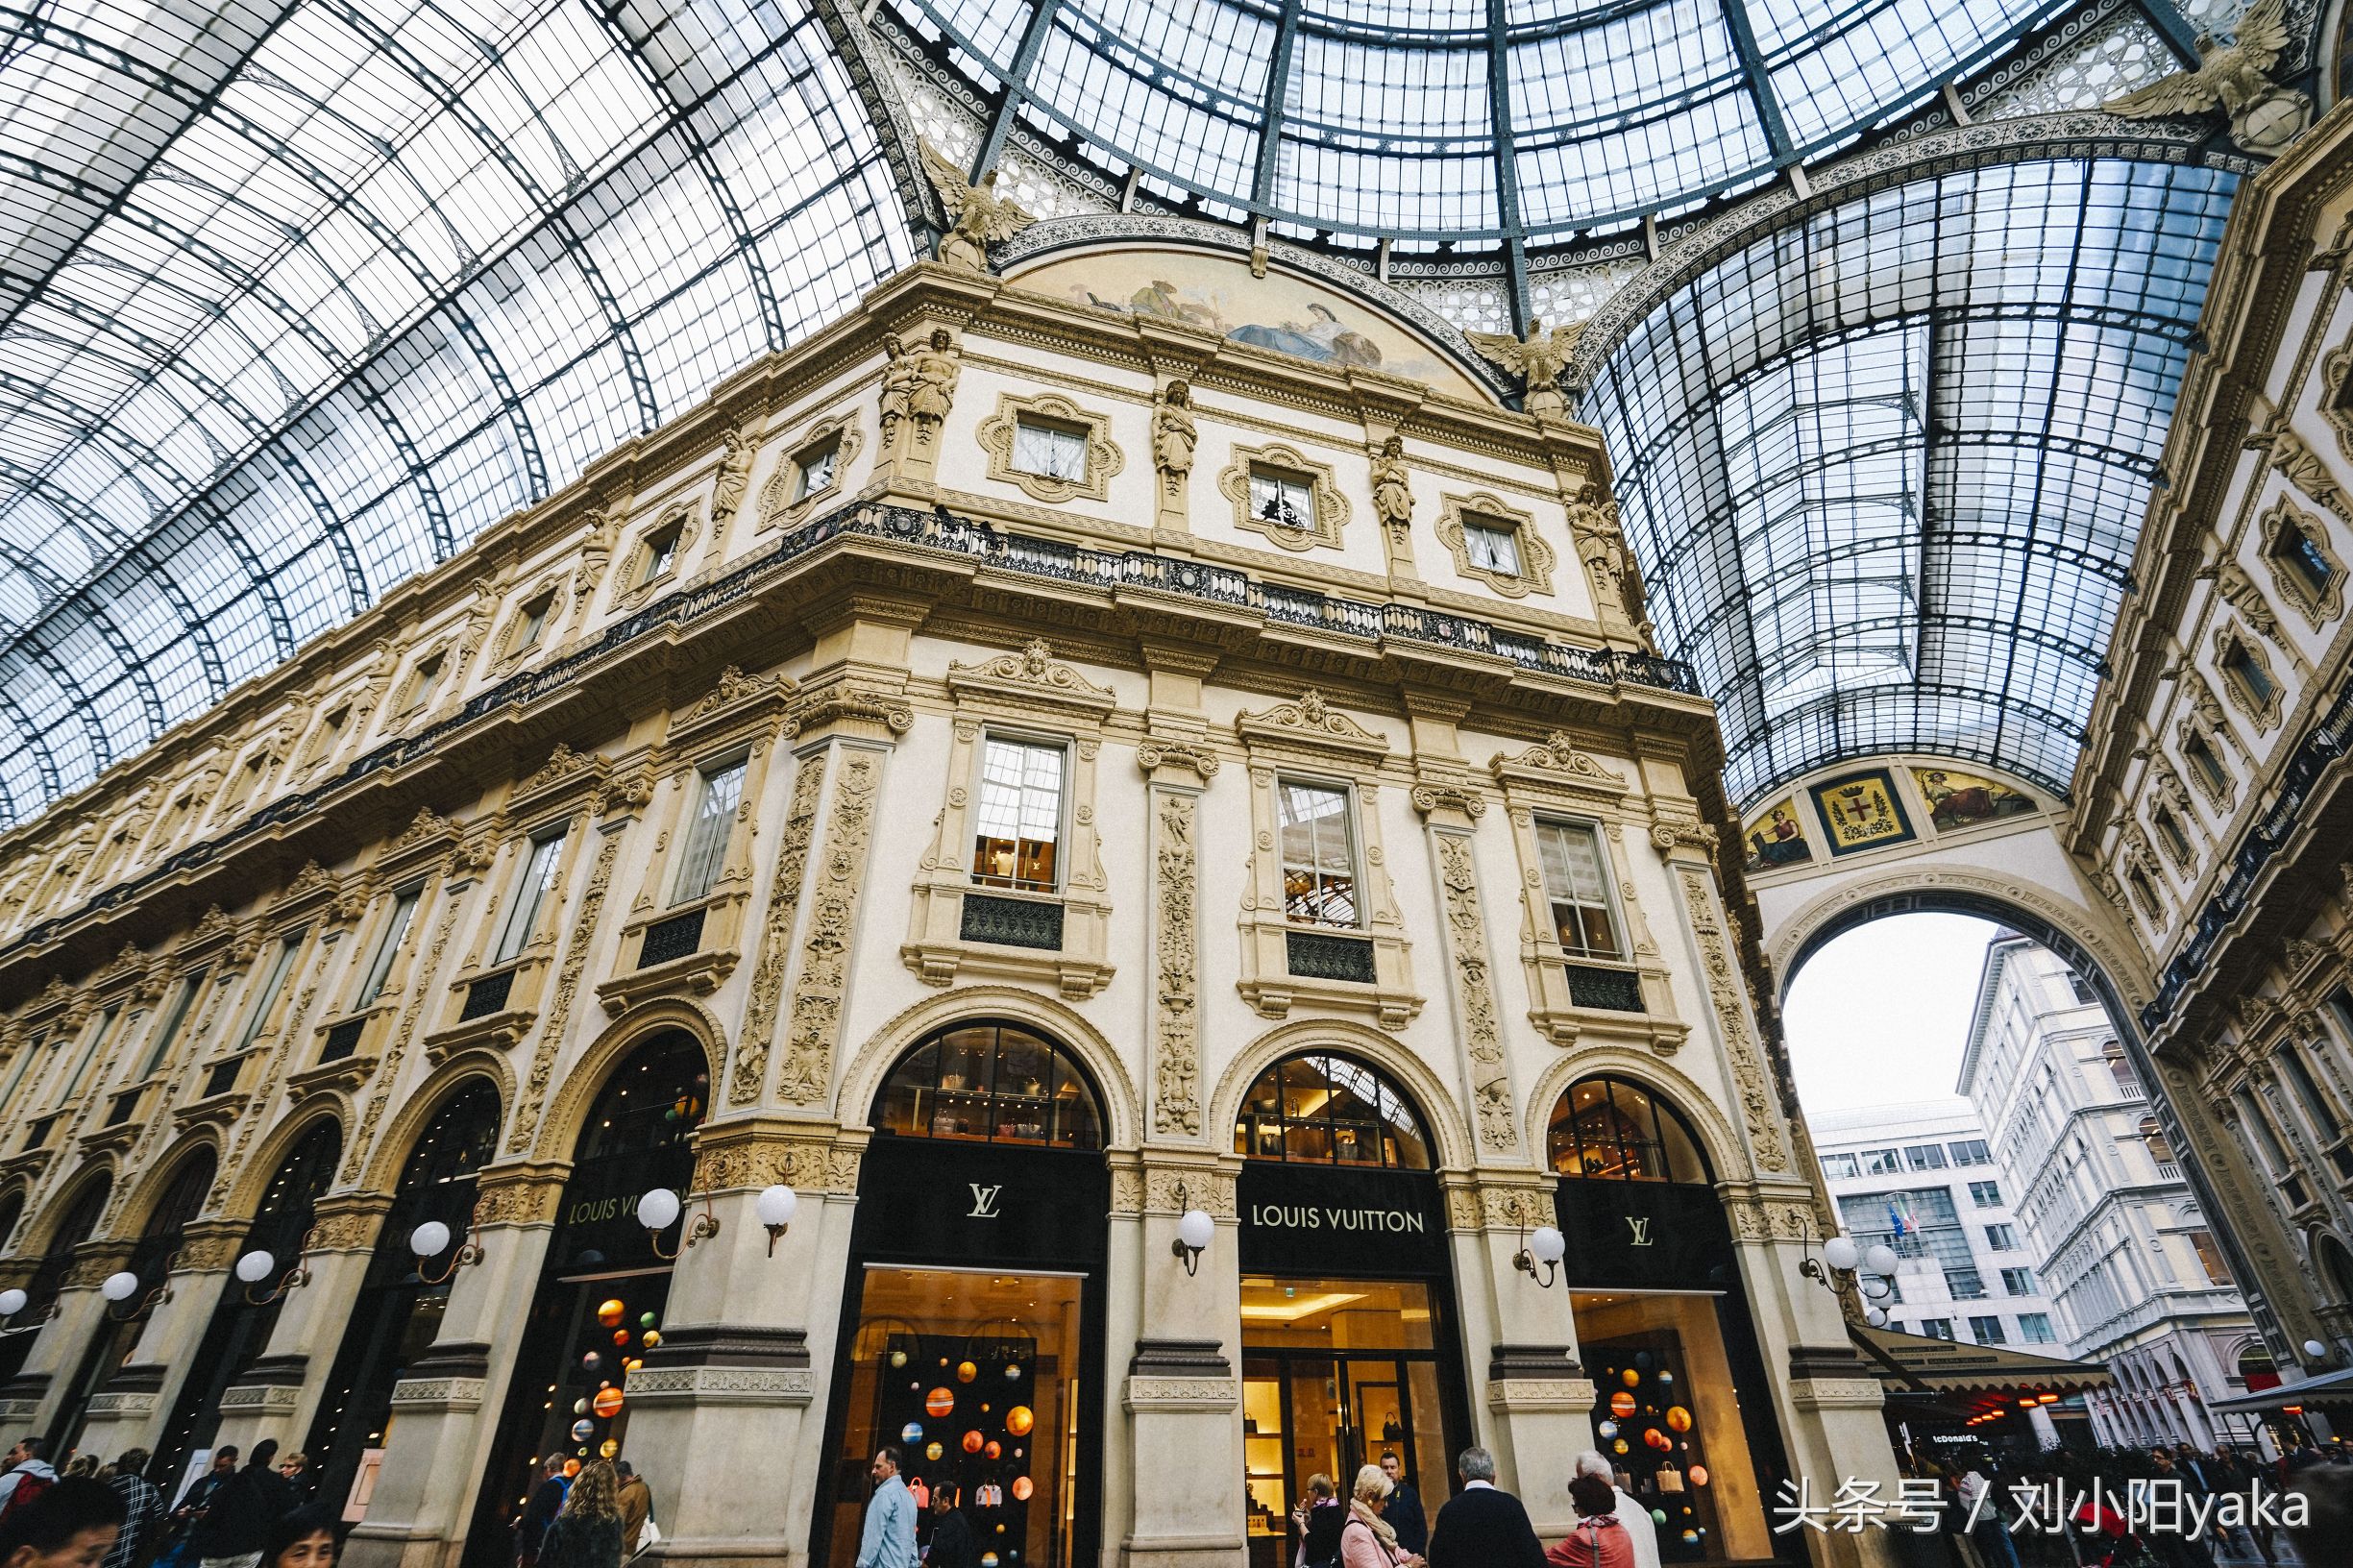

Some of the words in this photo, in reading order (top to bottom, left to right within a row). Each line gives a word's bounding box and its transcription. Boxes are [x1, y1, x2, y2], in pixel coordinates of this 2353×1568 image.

[569, 1197, 617, 1224] LOUIS
[1253, 1205, 1320, 1229] LOUIS
[1325, 1208, 1424, 1234] VUITTON
